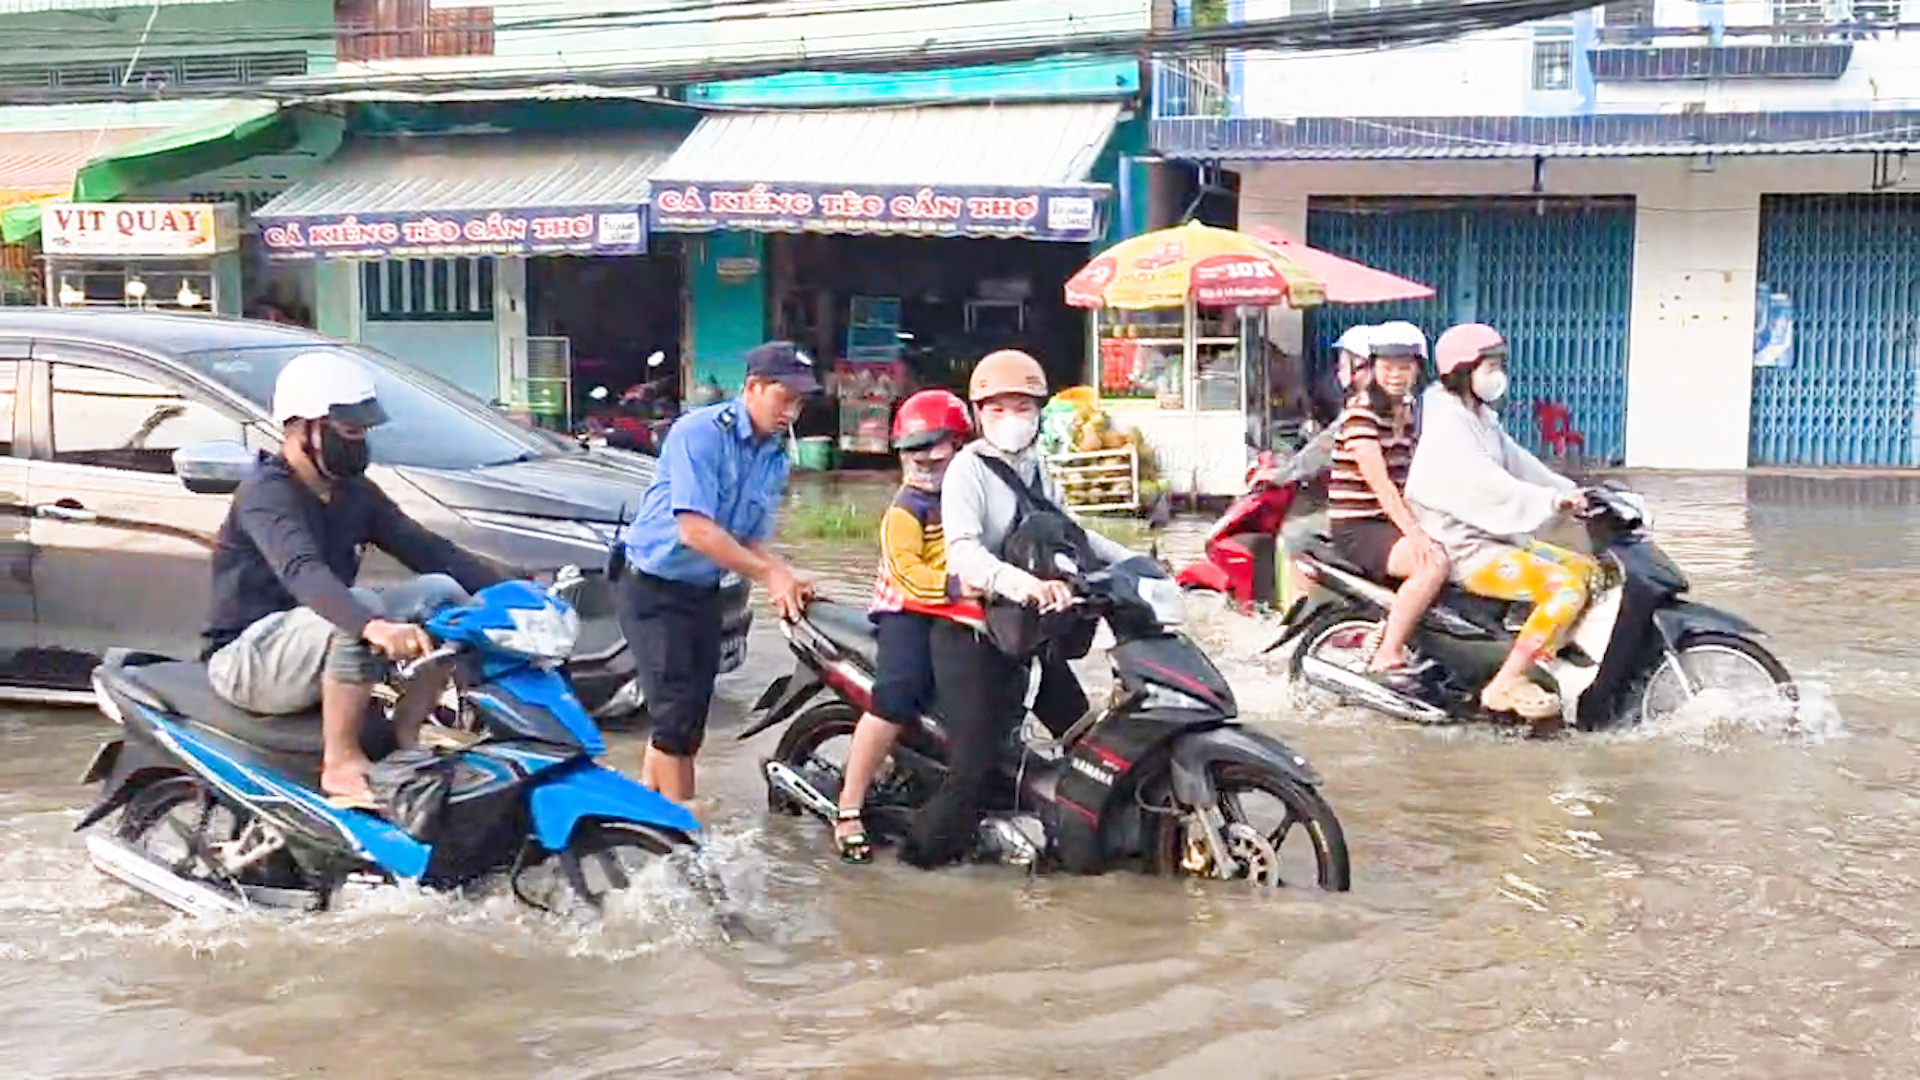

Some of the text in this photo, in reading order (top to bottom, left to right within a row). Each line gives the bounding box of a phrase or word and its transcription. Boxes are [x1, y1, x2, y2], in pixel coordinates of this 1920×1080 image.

[966, 195, 1039, 220] THƠ
[53, 210, 201, 236] VỊT QUAY
[530, 213, 593, 239] THƠ
[1226, 261, 1275, 278] 10K
[1071, 756, 1114, 787] YAMAHA
